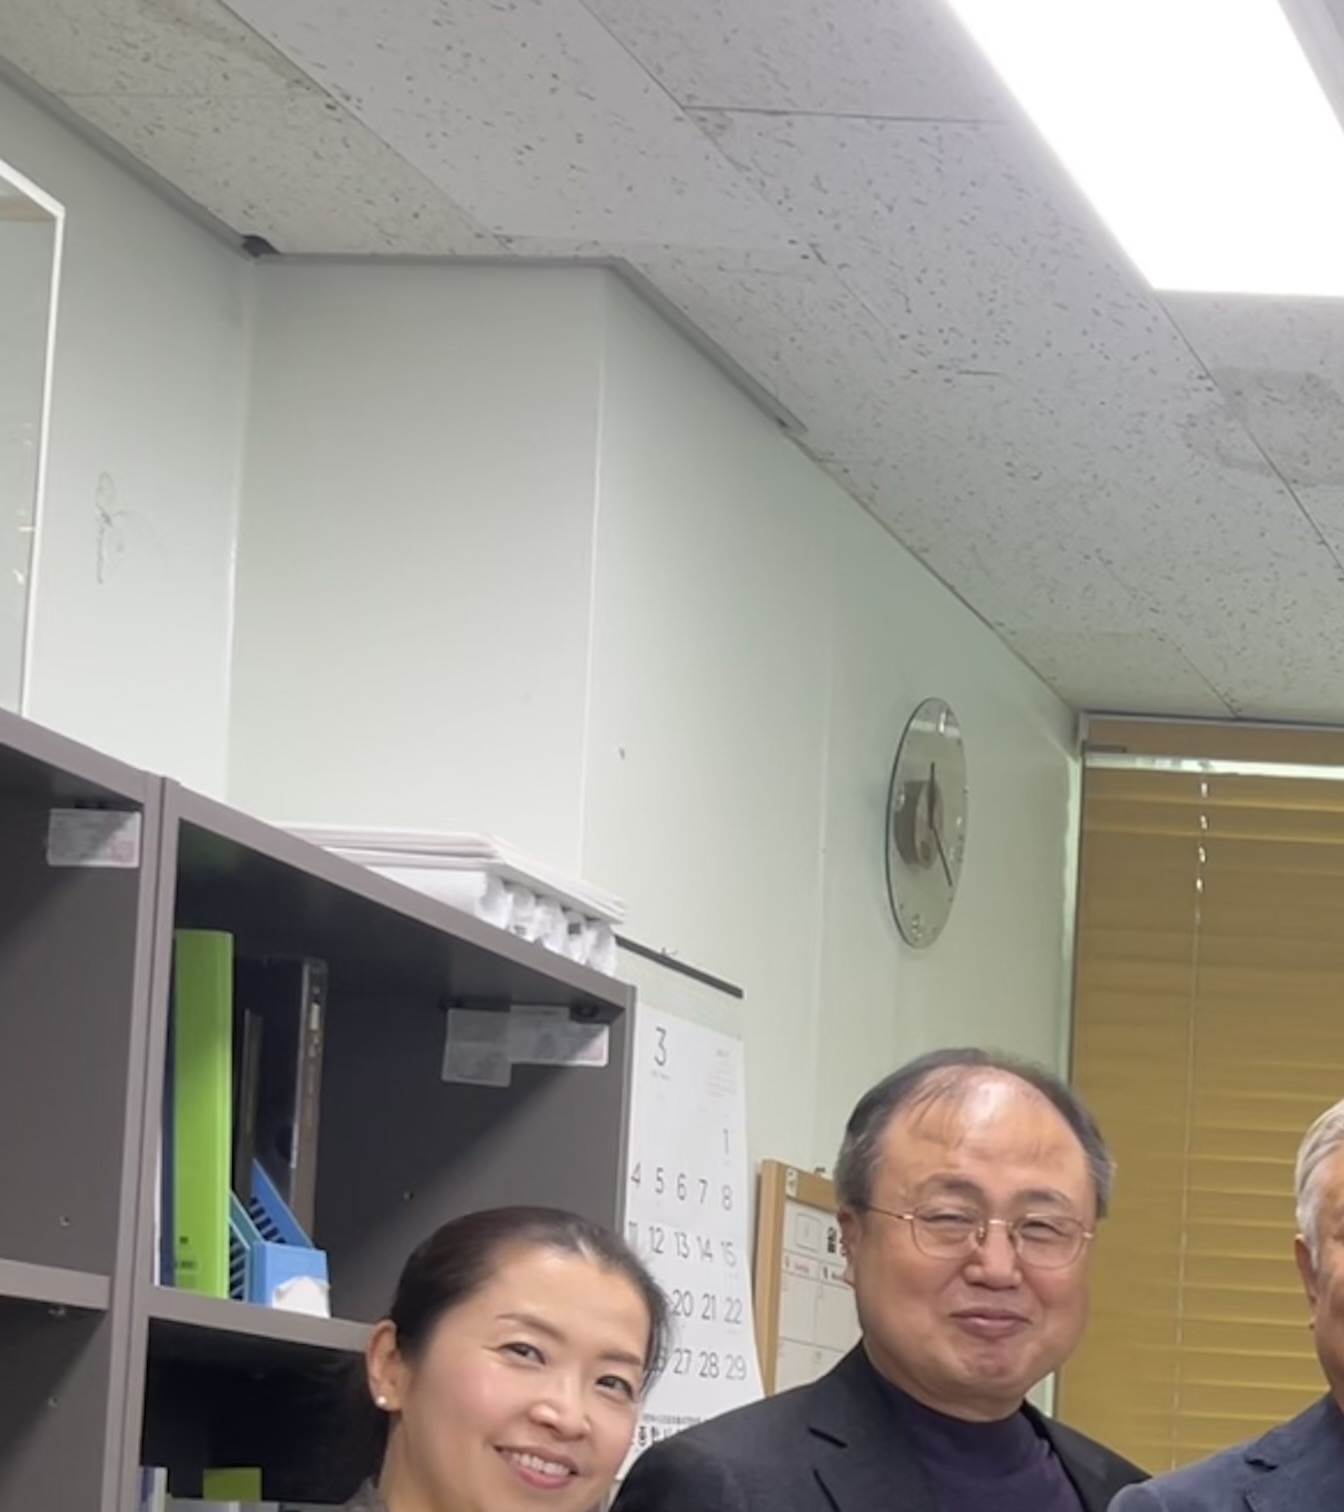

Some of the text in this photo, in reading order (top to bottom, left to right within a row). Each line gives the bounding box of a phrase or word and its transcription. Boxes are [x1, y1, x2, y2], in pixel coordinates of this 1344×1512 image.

[654, 1025, 667, 1067] 3
[722, 1127, 729, 1155] 1
[630, 1161, 733, 1211] 4 5 6 7 8
[649, 1226, 665, 1255] 12
[674, 1231, 690, 1259] 13
[696, 1235, 713, 1263] 14
[720, 1240, 737, 1268] 15
[672, 1289, 743, 1325] 20 21 22
[673, 1347, 692, 1375] 27
[698, 1350, 720, 1379] 28
[724, 1353, 748, 1382] 29
